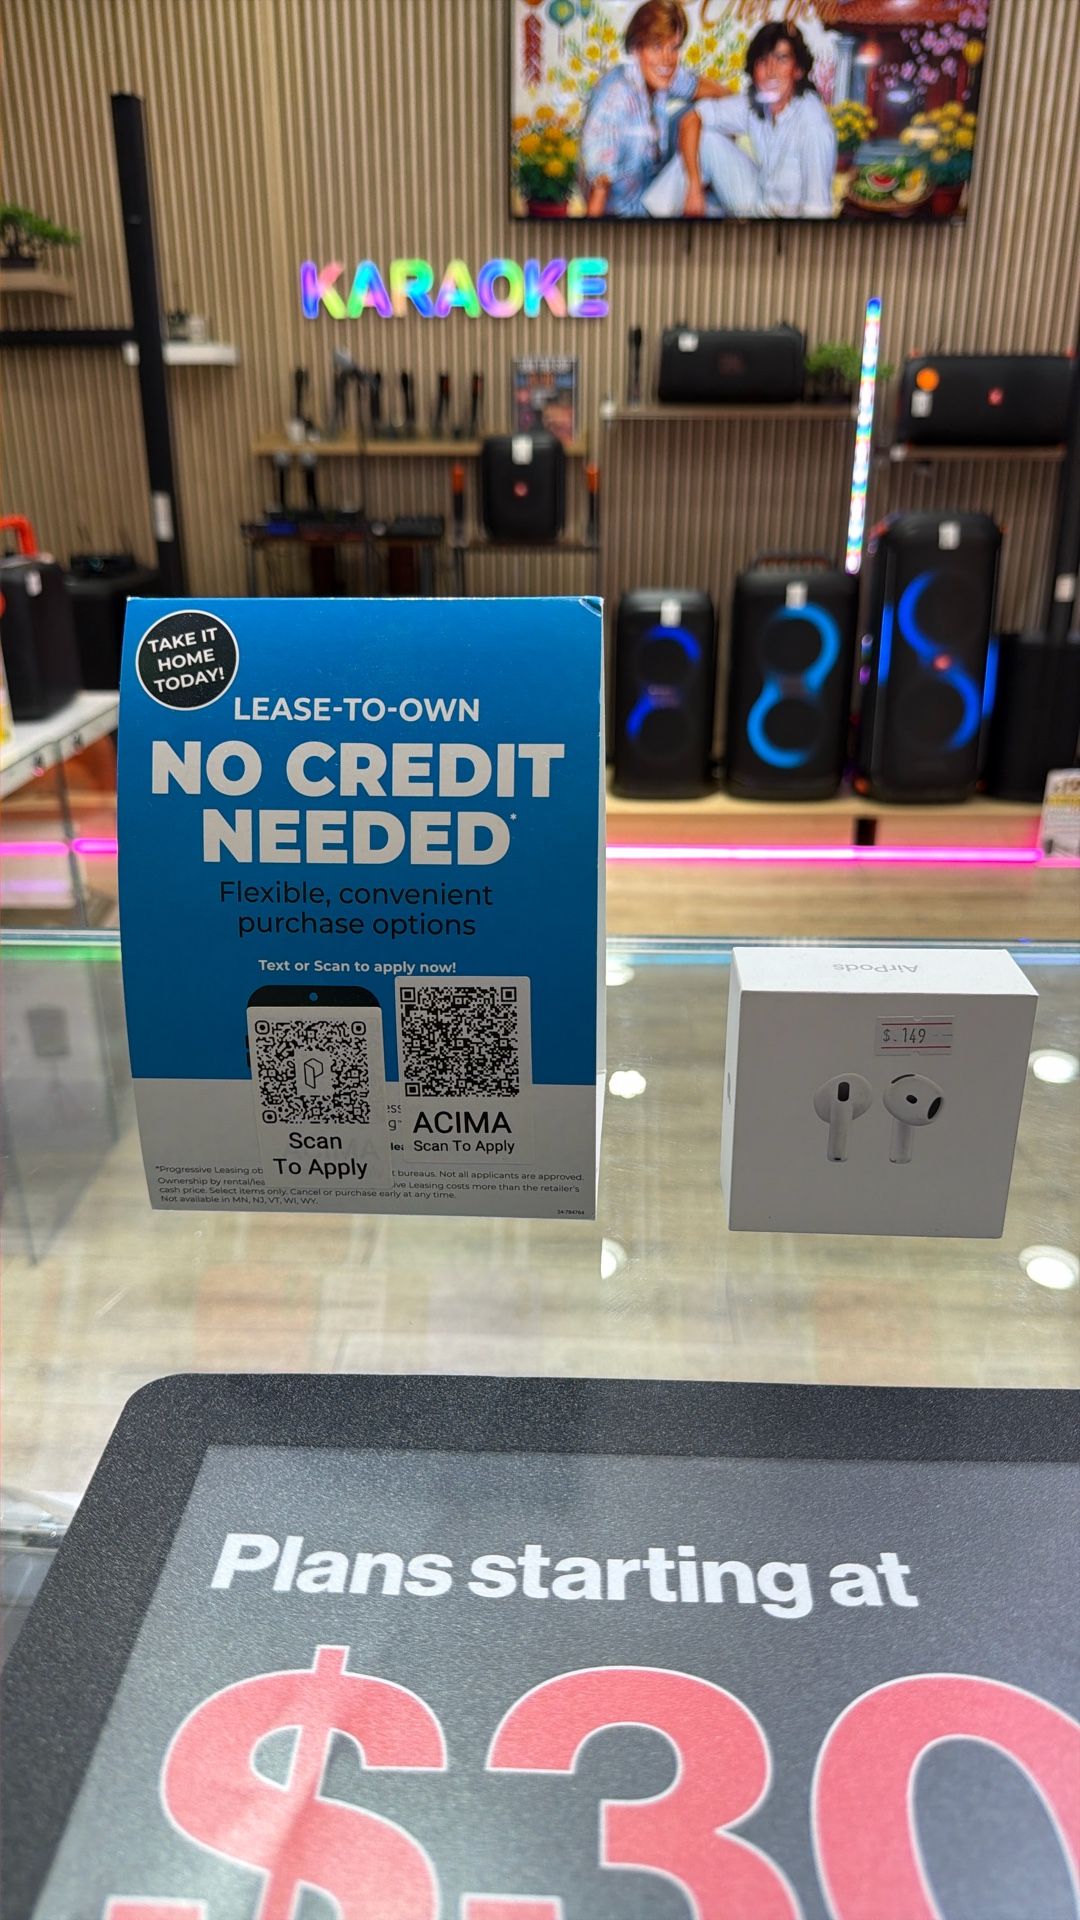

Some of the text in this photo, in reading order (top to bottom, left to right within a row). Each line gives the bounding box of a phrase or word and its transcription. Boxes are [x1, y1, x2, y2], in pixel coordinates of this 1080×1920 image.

[300, 257, 610, 320] KARAOKE
[147, 627, 218, 653] TAKE IT
[157, 648, 216, 672] HOME
[153, 666, 225, 693] TODAY!
[234, 697, 480, 722] LEASE-TO-OWN
[151, 740, 565, 798] NO CREDIT
[220, 880, 494, 908] Flexible, convenient
[238, 911, 476, 939] purchase options
[258, 959, 457, 975] Text or Scan to apply now!
[832, 964, 918, 973] AirPods
[413, 1111, 512, 1134] ACIMA
[289, 1132, 343, 1149] Scan
[413, 1140, 449, 1152] Scan
[452, 1140, 471, 1152] To
[475, 1139, 515, 1154] Apply
[214, 1166, 250, 1175] Leasing
[273, 1158, 302, 1175] To
[308, 1158, 368, 1180] Apply
[439, 1170, 457, 1178] Not
[458, 1170, 469, 1178] all
[471, 1171, 519, 1180] applicants
[157, 1177, 208, 1186] Ownership
[210, 1178, 221, 1186] by
[409, 1182, 444, 1190] Leasing
[180, 1195, 220, 1203] available
[232, 1196, 251, 1204] MN,
[252, 1196, 267, 1204] NJ,
[284, 1197, 299, 1205] WI,
[301, 1197, 319, 1205] WY.
[183, 1187, 207, 1195] price.
[209, 1187, 237, 1195] Select
[267, 1188, 288, 1196] only.
[290, 1188, 321, 1196] Cancel
[335, 1189, 377, 1198] purchase
[379, 1190, 401, 1199] early
[414, 1191, 431, 1199] any
[433, 1191, 456, 1199] time.
[210, 1533, 919, 1620] Plans starting at
[107, 1645, 1080, 1920] $30
